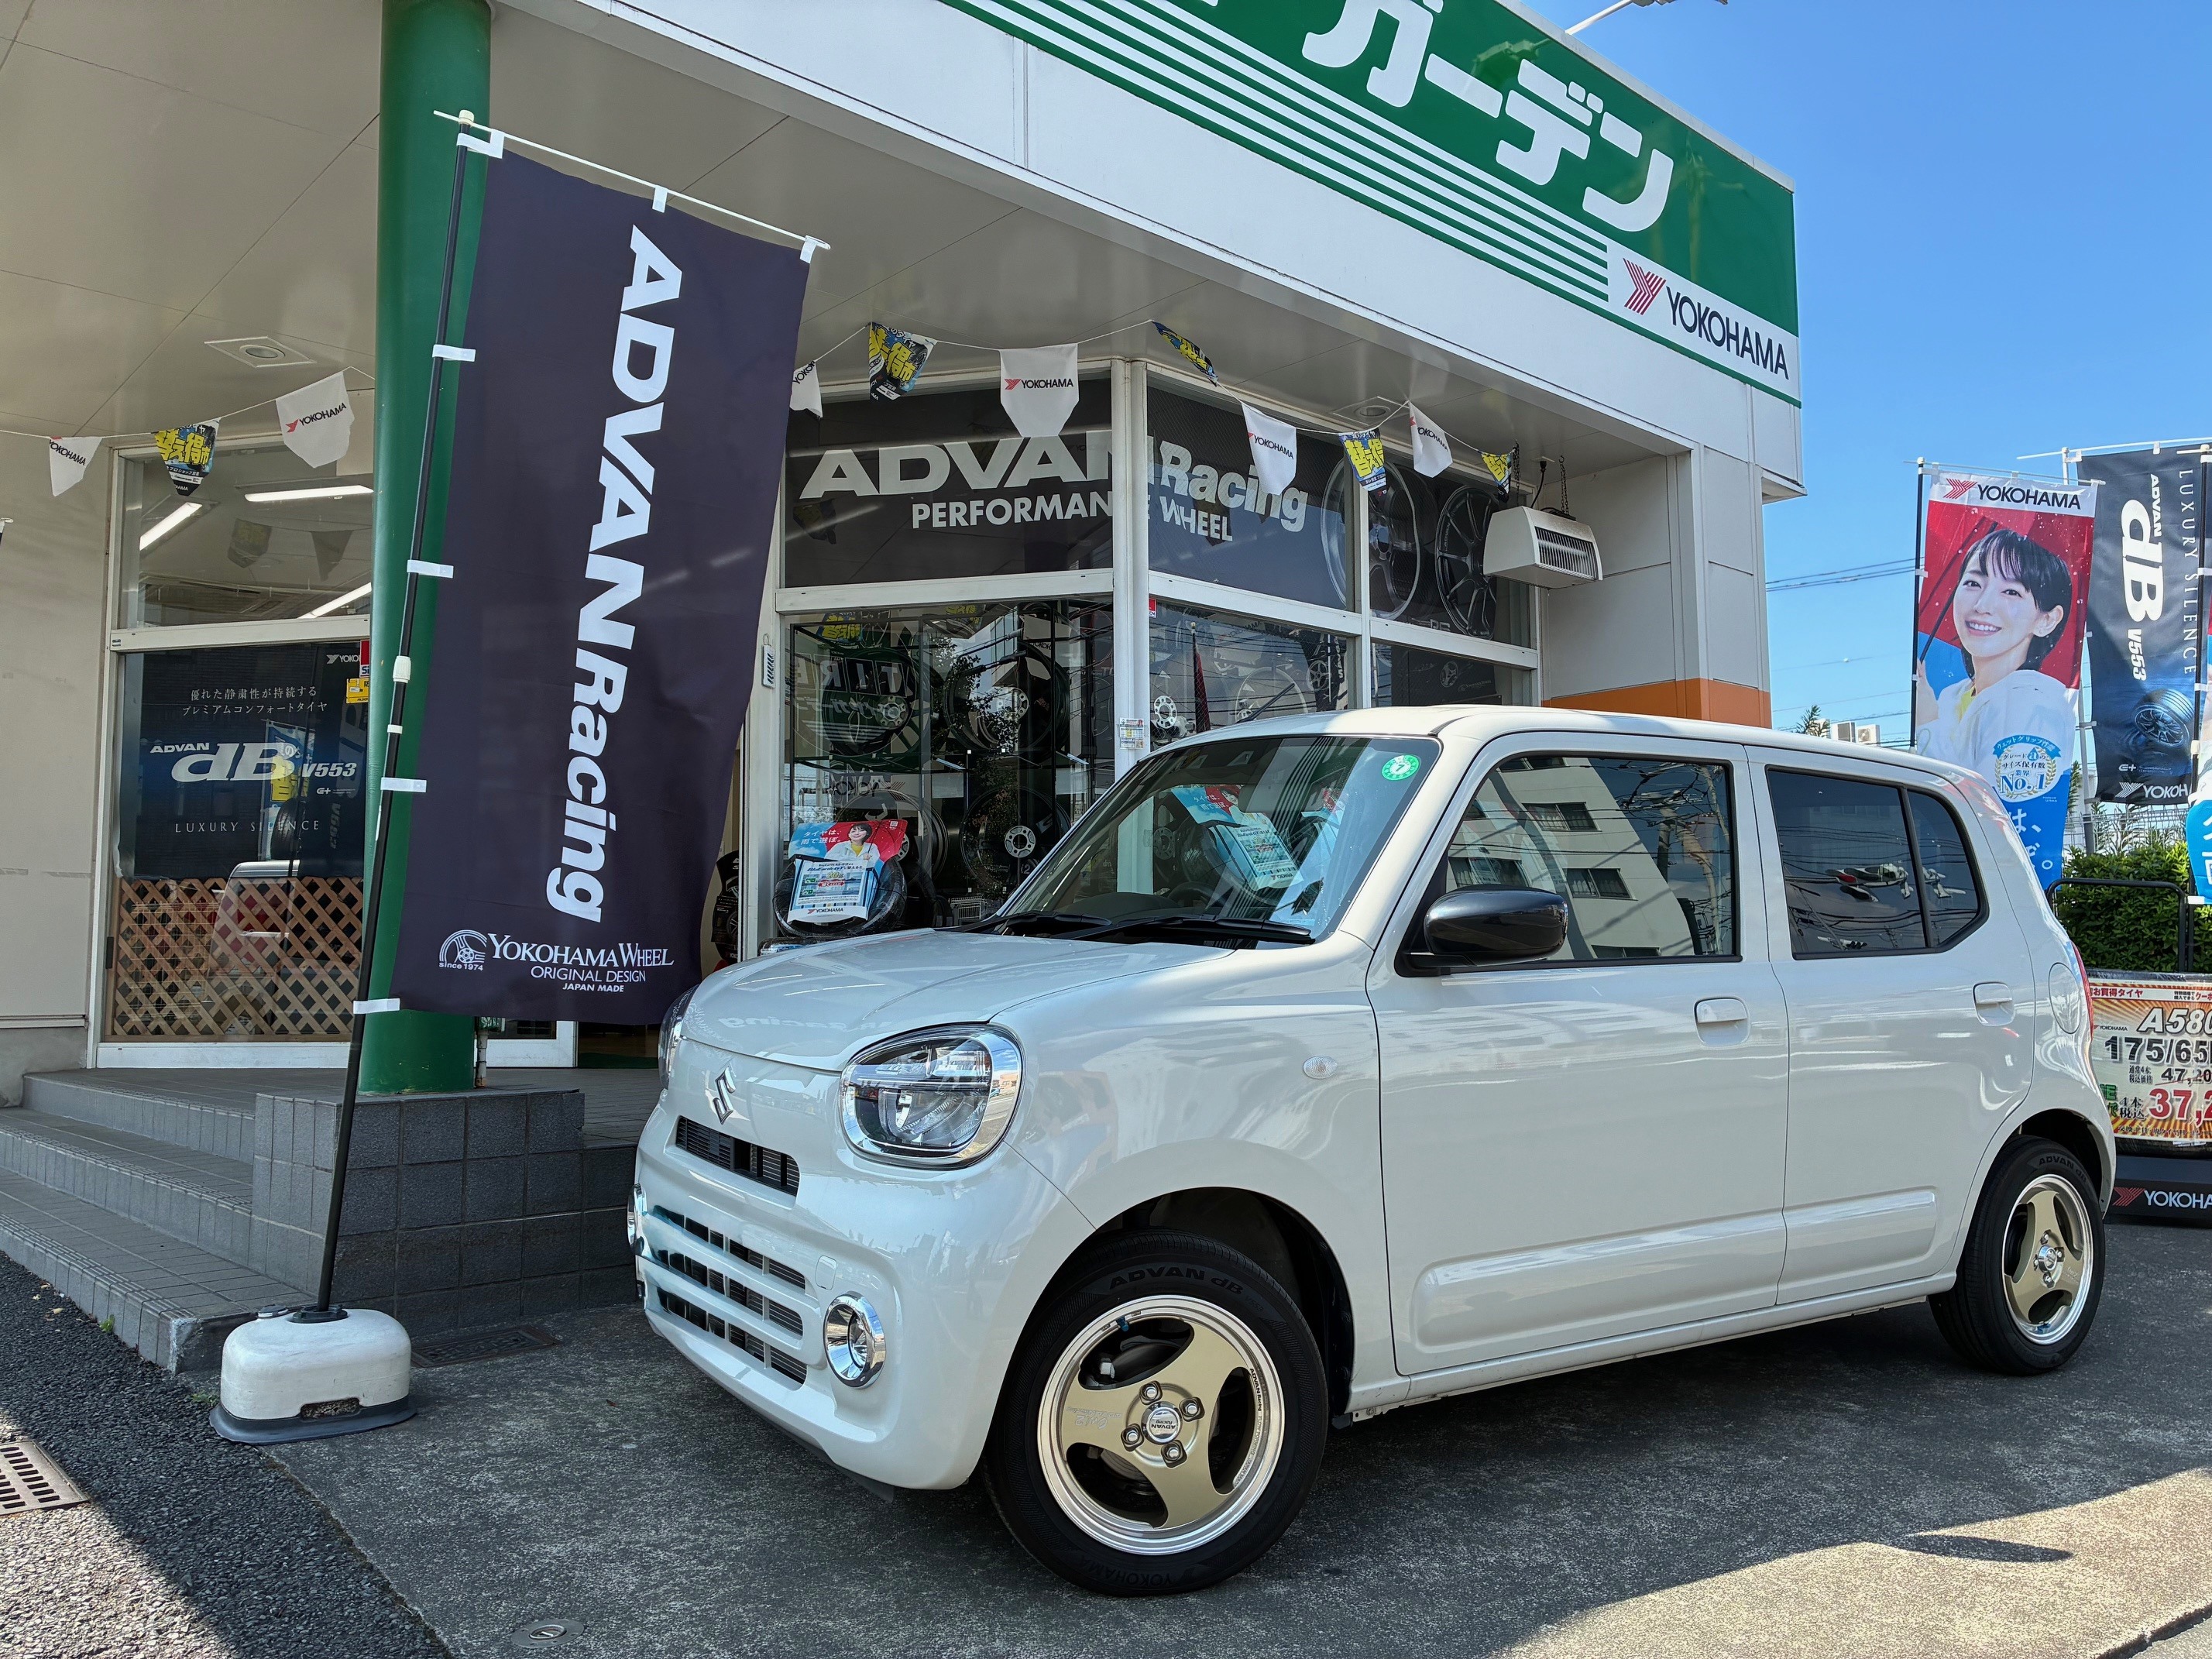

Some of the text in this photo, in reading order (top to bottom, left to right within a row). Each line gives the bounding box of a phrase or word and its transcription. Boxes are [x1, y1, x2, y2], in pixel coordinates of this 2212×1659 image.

[1666, 287, 1789, 380] YOKOHAMA
[1021, 378, 1074, 389] YOKOHAMA
[299, 402, 347, 426] YOKOHAMA
[1253, 434, 1294, 460] YOKOHAMA
[1977, 483, 2081, 510] YOKOHAMA
[2150, 473, 2162, 538] ADVAN
[1159, 496, 1233, 542] WHEEL
[2121, 499, 2164, 622] dB
[2179, 469, 2199, 675] LUXURY SILENCE
[340, 654, 360, 663] YOKO
[2128, 628, 2147, 682] V553
[191, 686, 317, 701] 優れた静粛性が持続する
[182, 702, 328, 716] プレミアムコンフォートタイヤ
[149, 742, 210, 754] ADVAN
[170, 743, 295, 782] dB
[301, 762, 357, 778] V553
[175, 820, 320, 833] LUXURY SILENCE
[487, 933, 675, 967] YOKOHAMA WHEEL
[531, 966, 647, 984] ORIGINAL DESIGN
[562, 983, 624, 993] JAPAN MADE
[2039, 1156, 2074, 1170] ADVAN
[1108, 1266, 1205, 1290] ADVAN
[1210, 1276, 1245, 1295] dB
[1250, 1368, 1261, 1394] ADVAN
